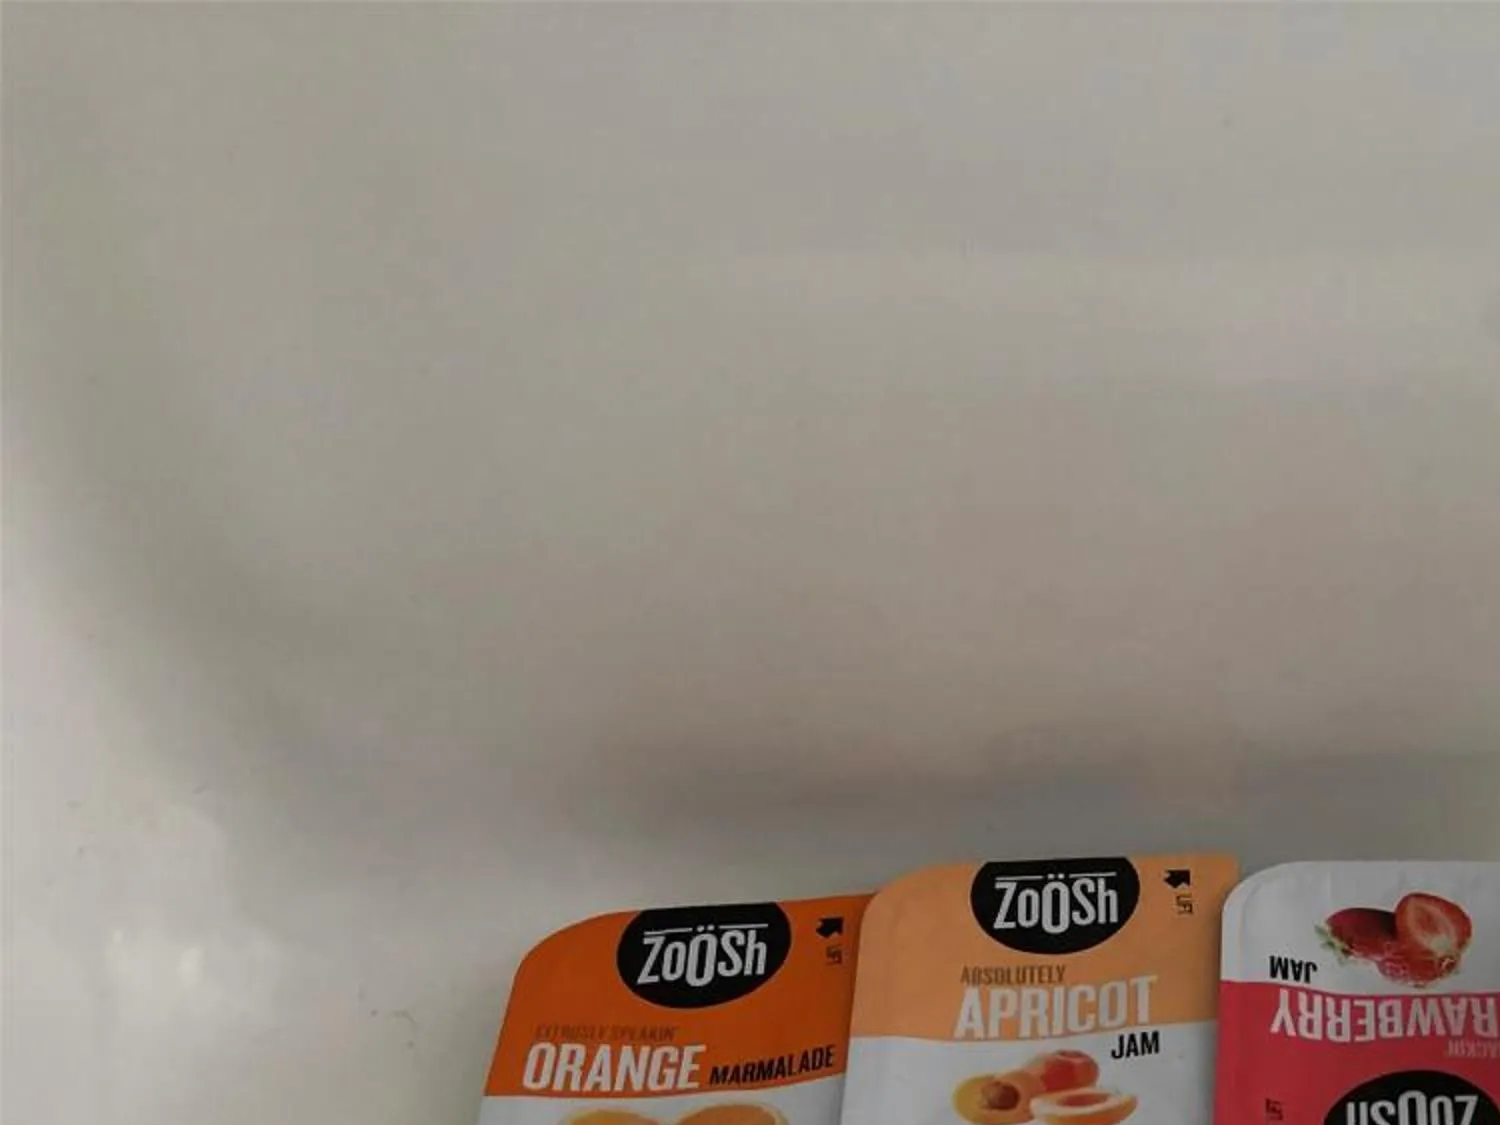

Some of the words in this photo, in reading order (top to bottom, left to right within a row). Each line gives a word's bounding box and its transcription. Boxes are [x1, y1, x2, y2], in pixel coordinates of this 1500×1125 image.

[960, 965, 1066, 986] ABSOLUTELY
[1269, 955, 1318, 984] JAM
[953, 975, 1158, 1040] APRICOT
[1111, 1030, 1160, 1060] JAM
[522, 1042, 706, 1092] ORANGE
[709, 1044, 837, 1087] MARMALADE
